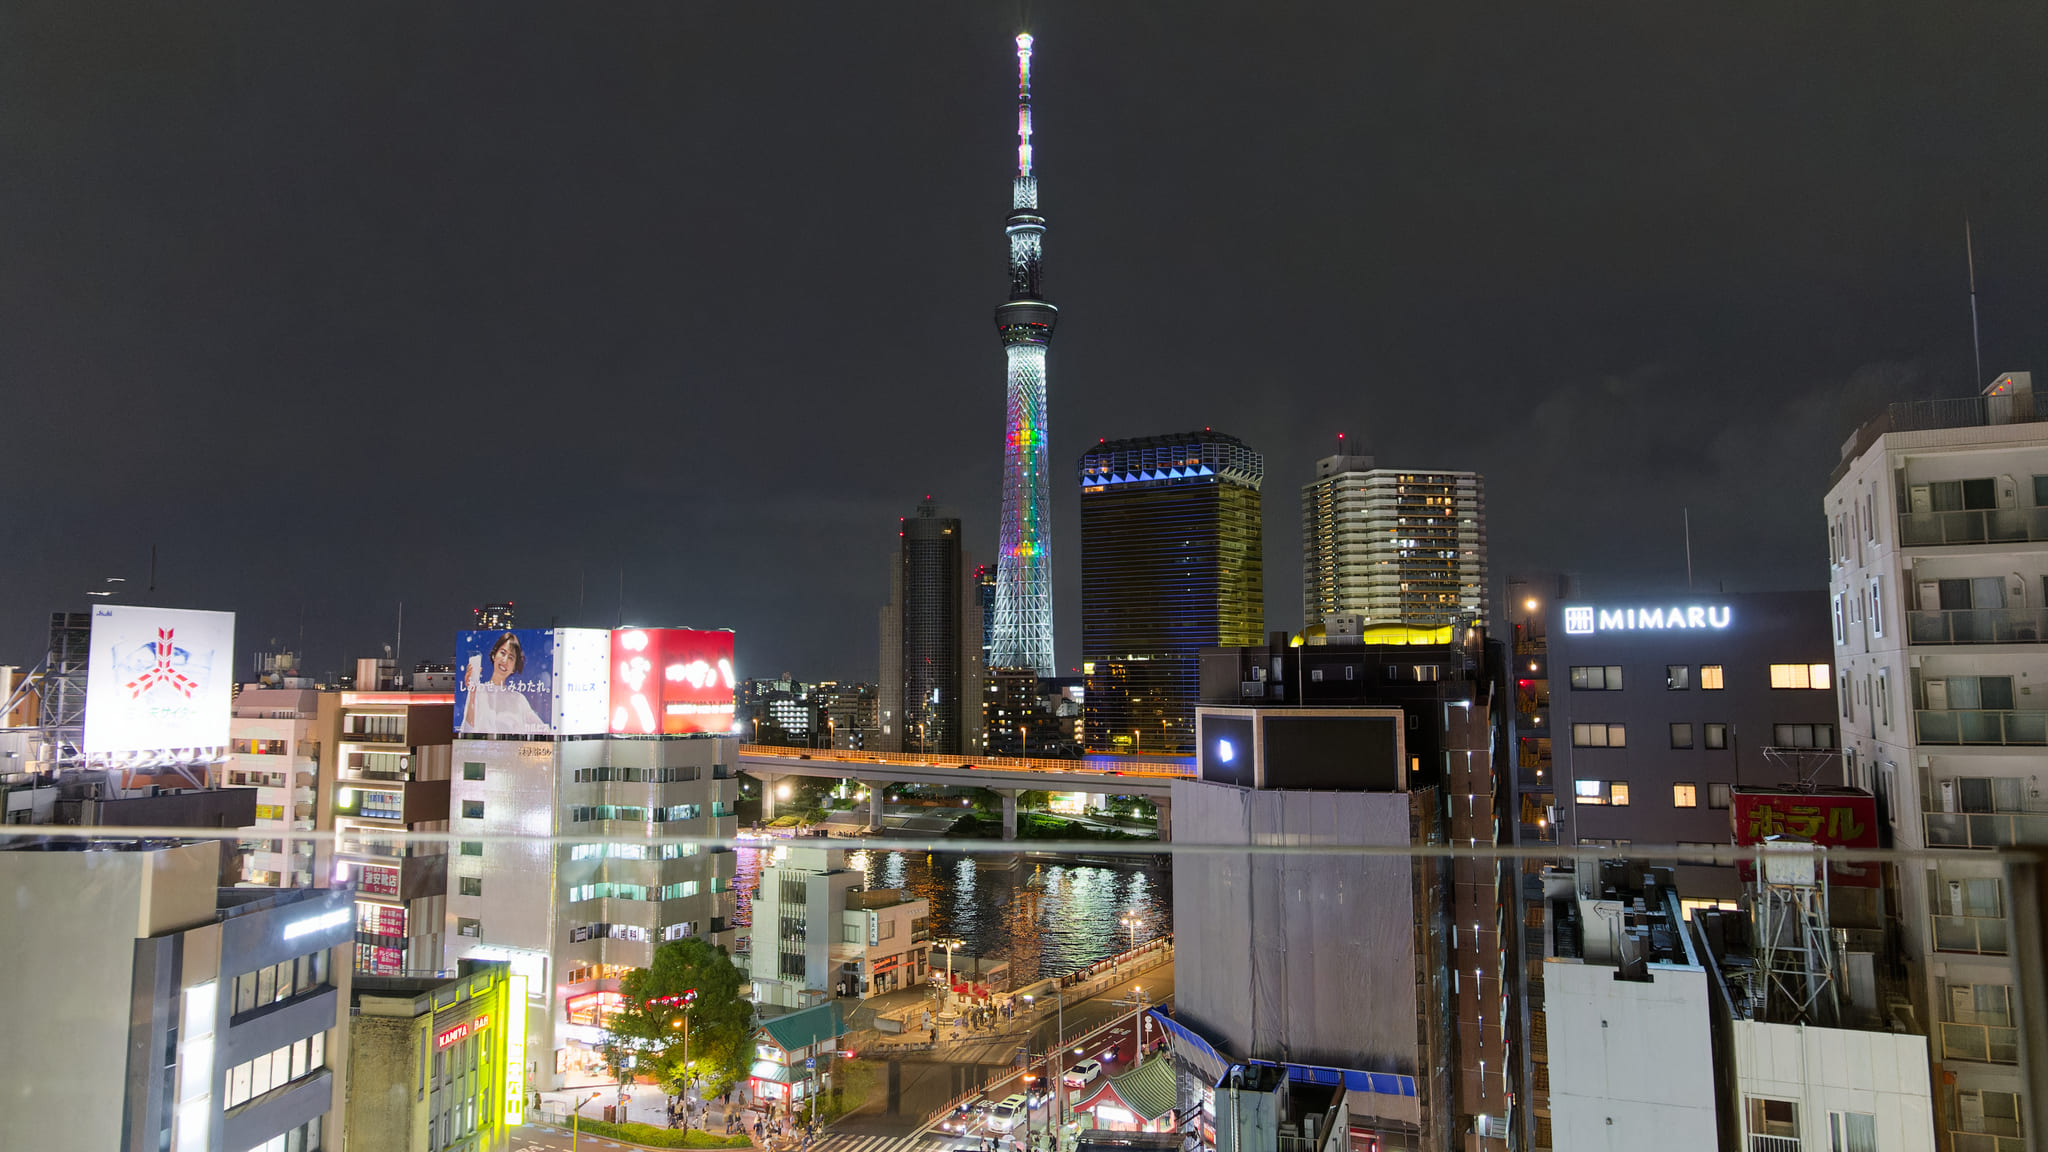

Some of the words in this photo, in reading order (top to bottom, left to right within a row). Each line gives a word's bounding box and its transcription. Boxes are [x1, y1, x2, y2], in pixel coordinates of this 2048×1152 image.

[1599, 606, 1731, 630] MIMARU
[1749, 804, 1865, 841] ホテル
[439, 1024, 468, 1047] KAMIYA
[474, 1014, 490, 1031] BAR
